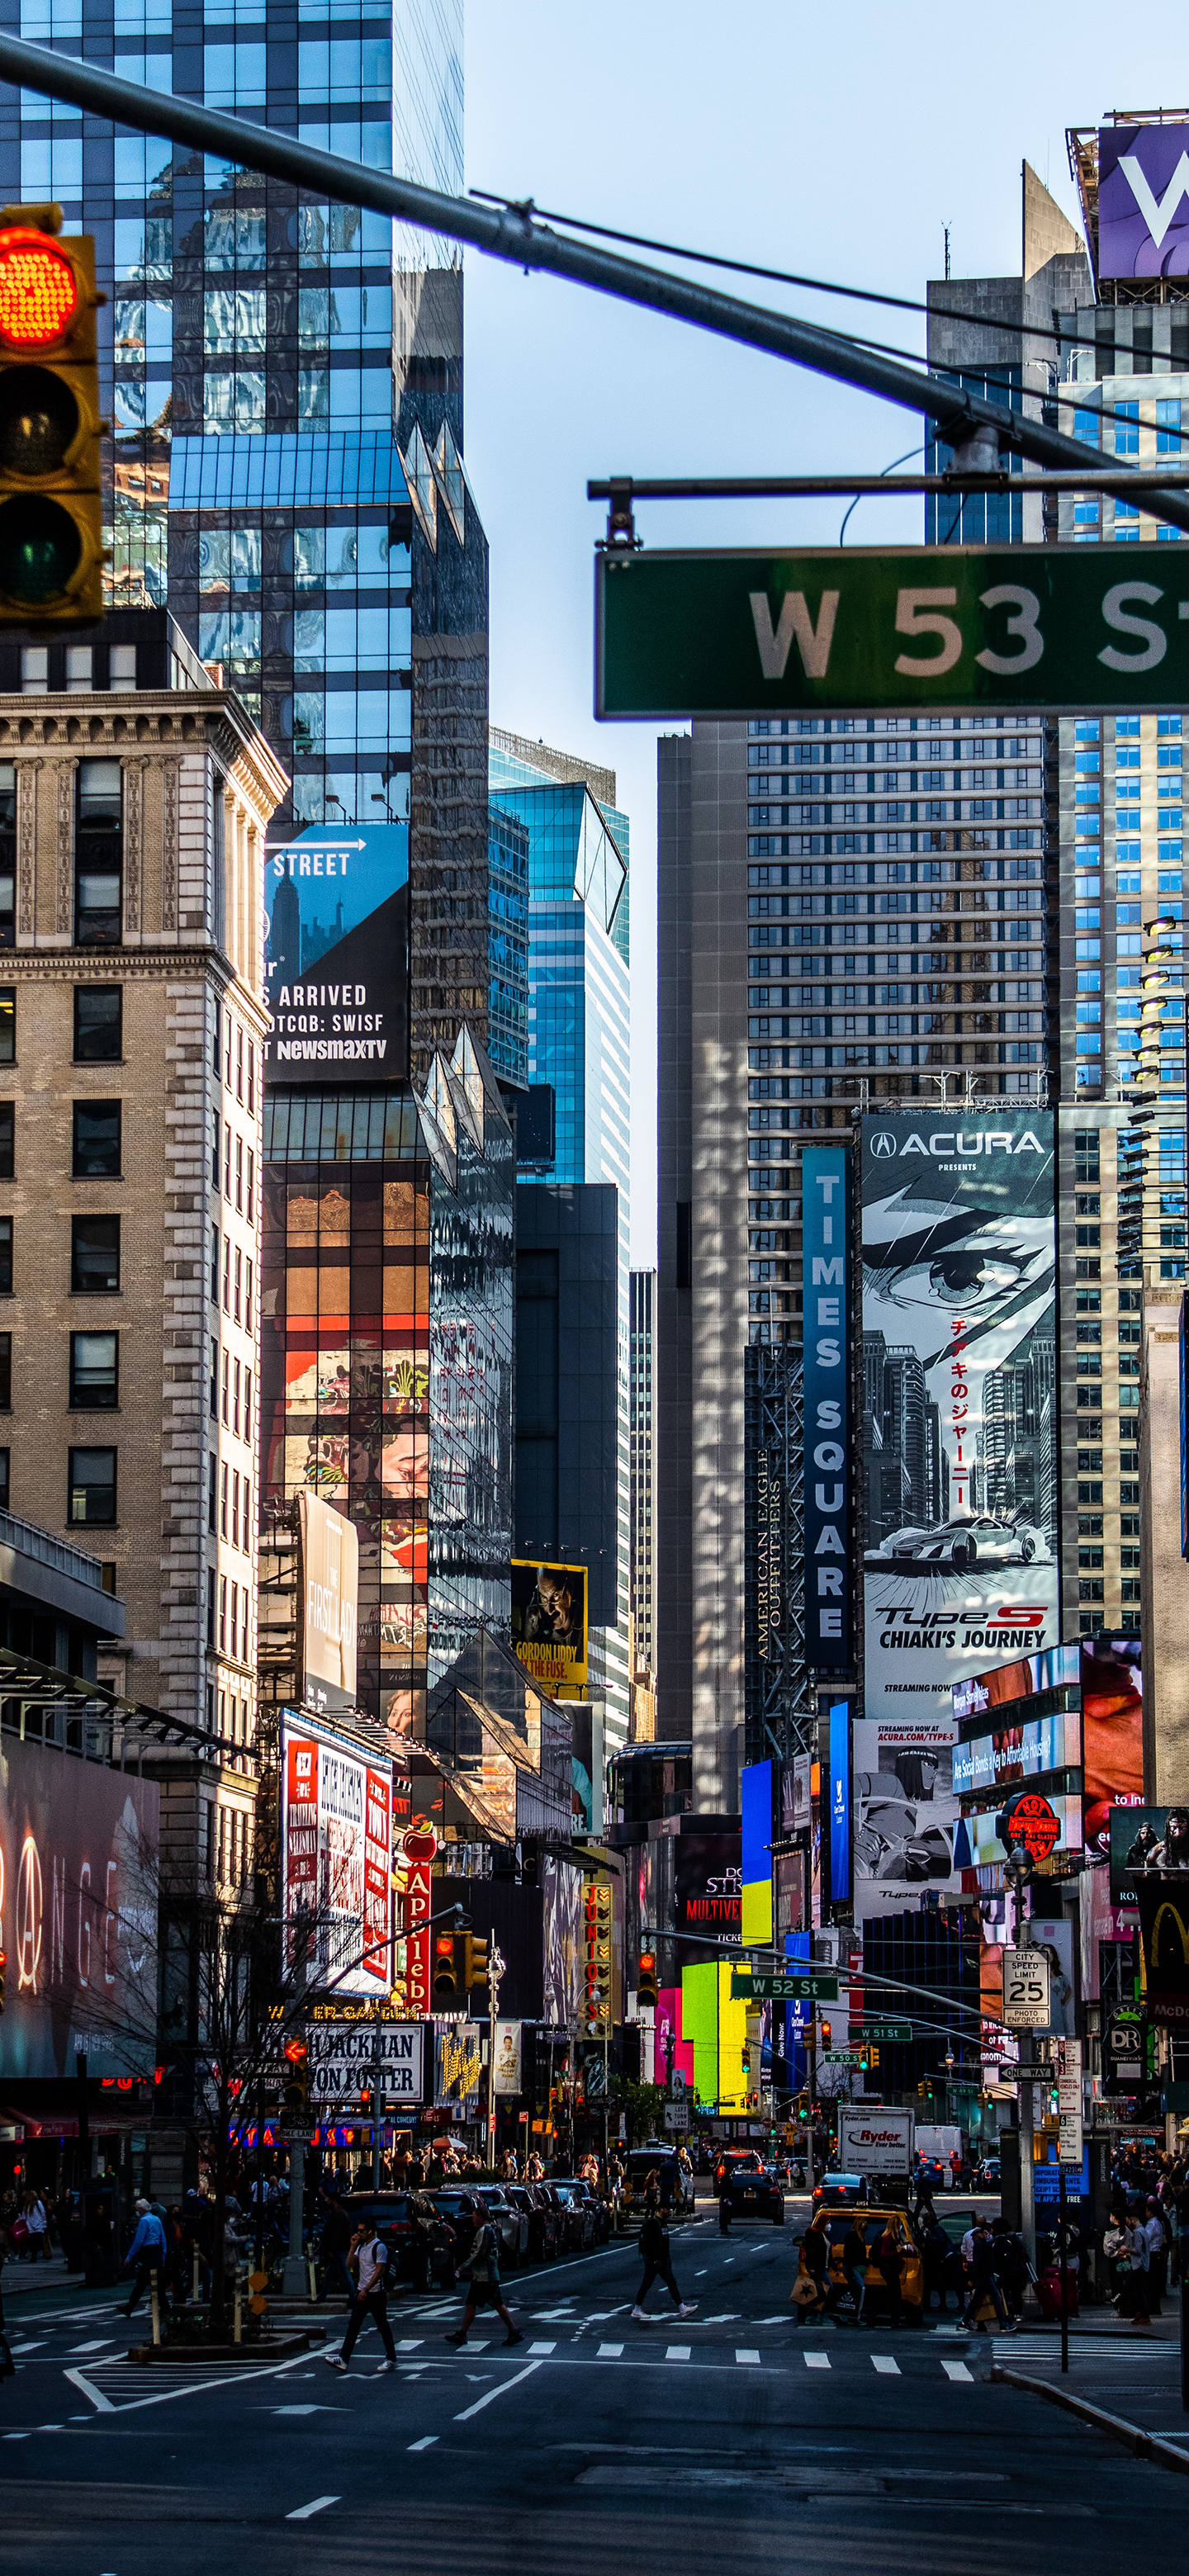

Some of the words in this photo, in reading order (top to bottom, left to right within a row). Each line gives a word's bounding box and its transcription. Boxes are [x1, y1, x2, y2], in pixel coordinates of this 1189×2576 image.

[749, 590, 840, 679] W
[894, 585, 1044, 676] 53
[1097, 581, 1189, 672] S
[273, 854, 350, 875] STREET
[279, 985, 366, 1006] ARRIVED
[332, 1015, 383, 1031] SWISF
[899, 1132, 1045, 1156] ACURA
[938, 1163, 977, 1172] PRESENTS
[812, 1176, 844, 1367] TIMES
[950, 1320, 969, 1503] チアキのジャーニー
[758, 1449, 769, 1524] EAGLE
[813, 1400, 846, 1637] SQUARE
[770, 1480, 781, 1627] OUTFITTERS
[758, 1532, 769, 1660] AMERICAN
[308, 1580, 334, 1634] FIRST
[335, 1595, 358, 1647] LADY
[875, 1607, 988, 1627] Type
[987, 1607, 1049, 1627] S
[879, 1631, 955, 1648] CHIAKI'S
[961, 1630, 1047, 1648] JOURNEY
[516, 1641, 552, 1660] GORDON
[553, 1645, 577, 1663] LIDDY
[530, 1660, 545, 1677] THE
[884, 1683, 931, 1693] STREAMING
[934, 1683, 951, 1693] NOW
[878, 1733, 954, 1741] ACURA.COM/TYPE-S
[962, 1756, 975, 1776] Social
[975, 1752, 989, 1773] Bonds
[1022, 1800, 1045, 1812] HOT
[1115, 1796, 1127, 1805] to
[752, 1980, 765, 1993] W
[772, 1981, 793, 1994] 52
[801, 1982, 818, 1995] St
[1009, 1982, 1043, 2001] 25
[887, 2029, 898, 2037] St
[1030, 2068, 1047, 2076] WAY
[281, 2129, 296, 2138] BIKE
[297, 2129, 315, 2138] LANE
[860, 2130, 901, 2143] Ryder
